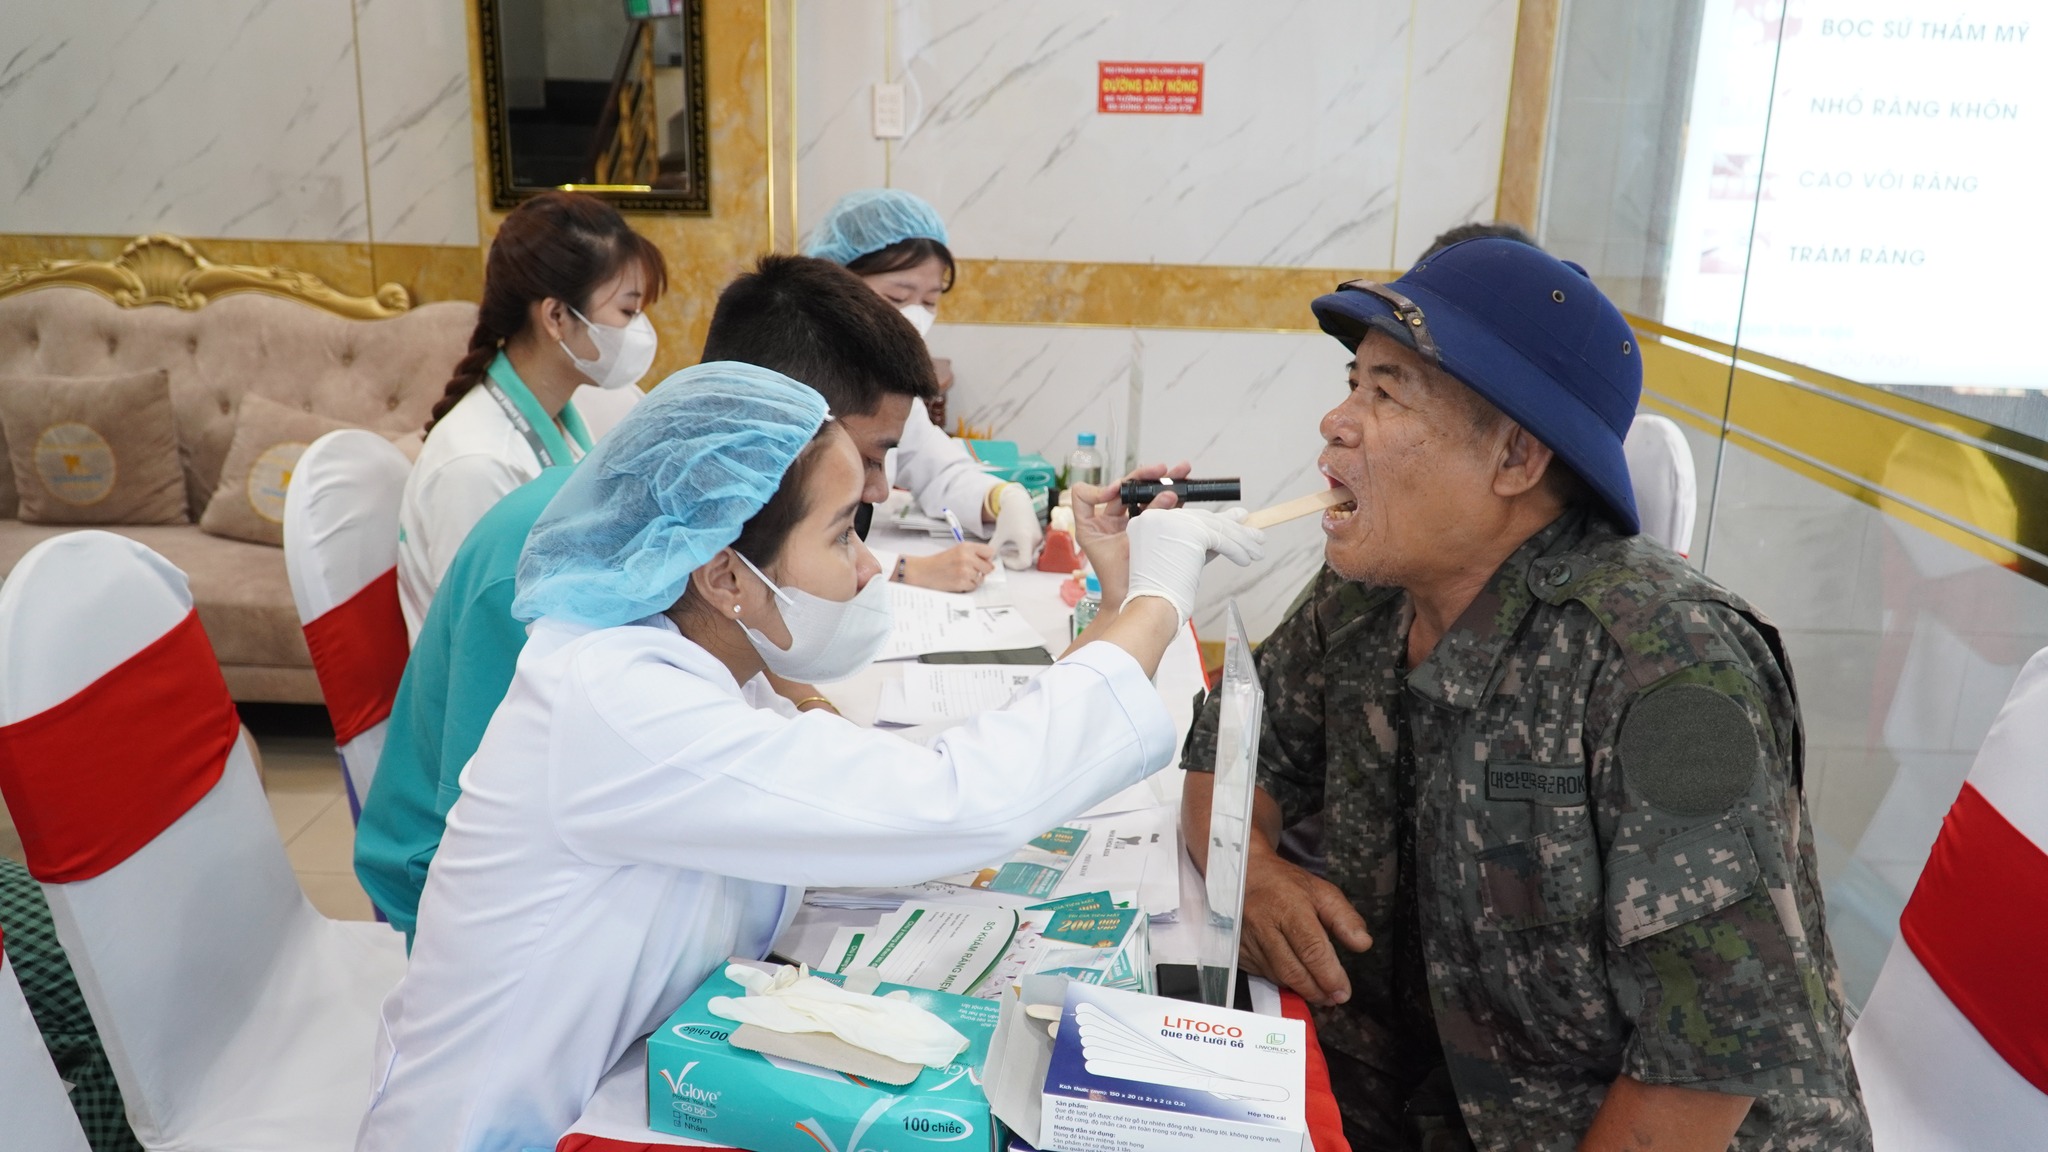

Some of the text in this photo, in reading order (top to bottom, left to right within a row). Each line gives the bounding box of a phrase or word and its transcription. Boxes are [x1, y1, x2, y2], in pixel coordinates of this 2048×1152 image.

[1950, 99, 2018, 120] KHÔN
[938, 974, 957, 992] MIỆN
[710, 1030, 729, 1042] 00
[1163, 1015, 1243, 1038] LITOCO
[1161, 1029, 1244, 1049] Que Đè Lưỡi Gỗ
[902, 1116, 962, 1134] 100 chiếc
